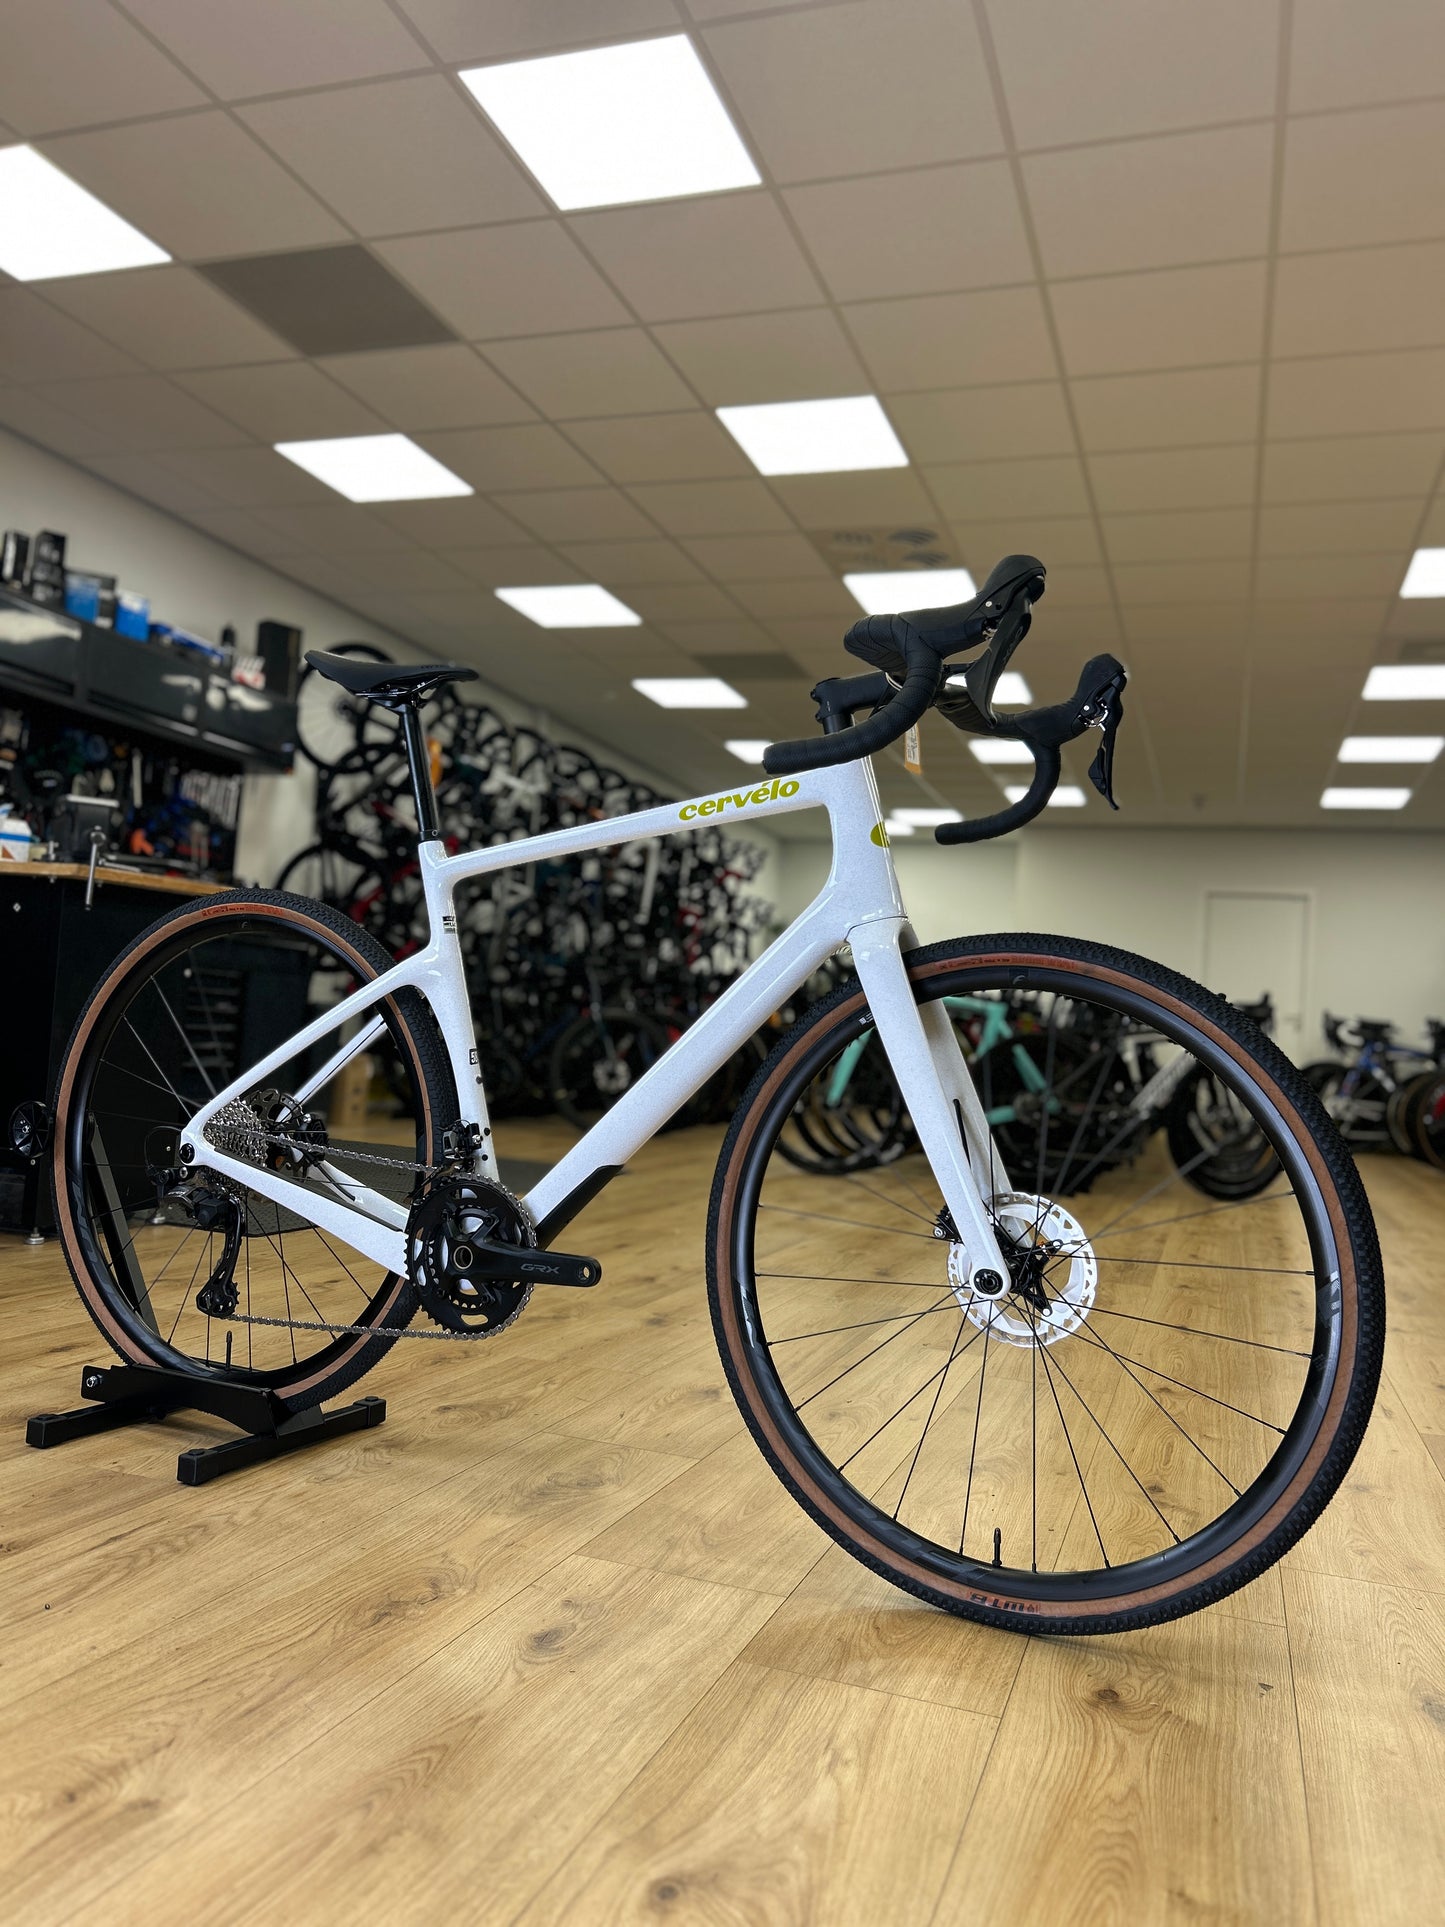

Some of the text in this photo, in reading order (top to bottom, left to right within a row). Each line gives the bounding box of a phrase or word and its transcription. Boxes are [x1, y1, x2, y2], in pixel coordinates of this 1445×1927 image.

[679, 779, 800, 820] cervélo
[520, 1263, 560, 1274] GRX
[970, 1593, 1024, 1612] WTB
